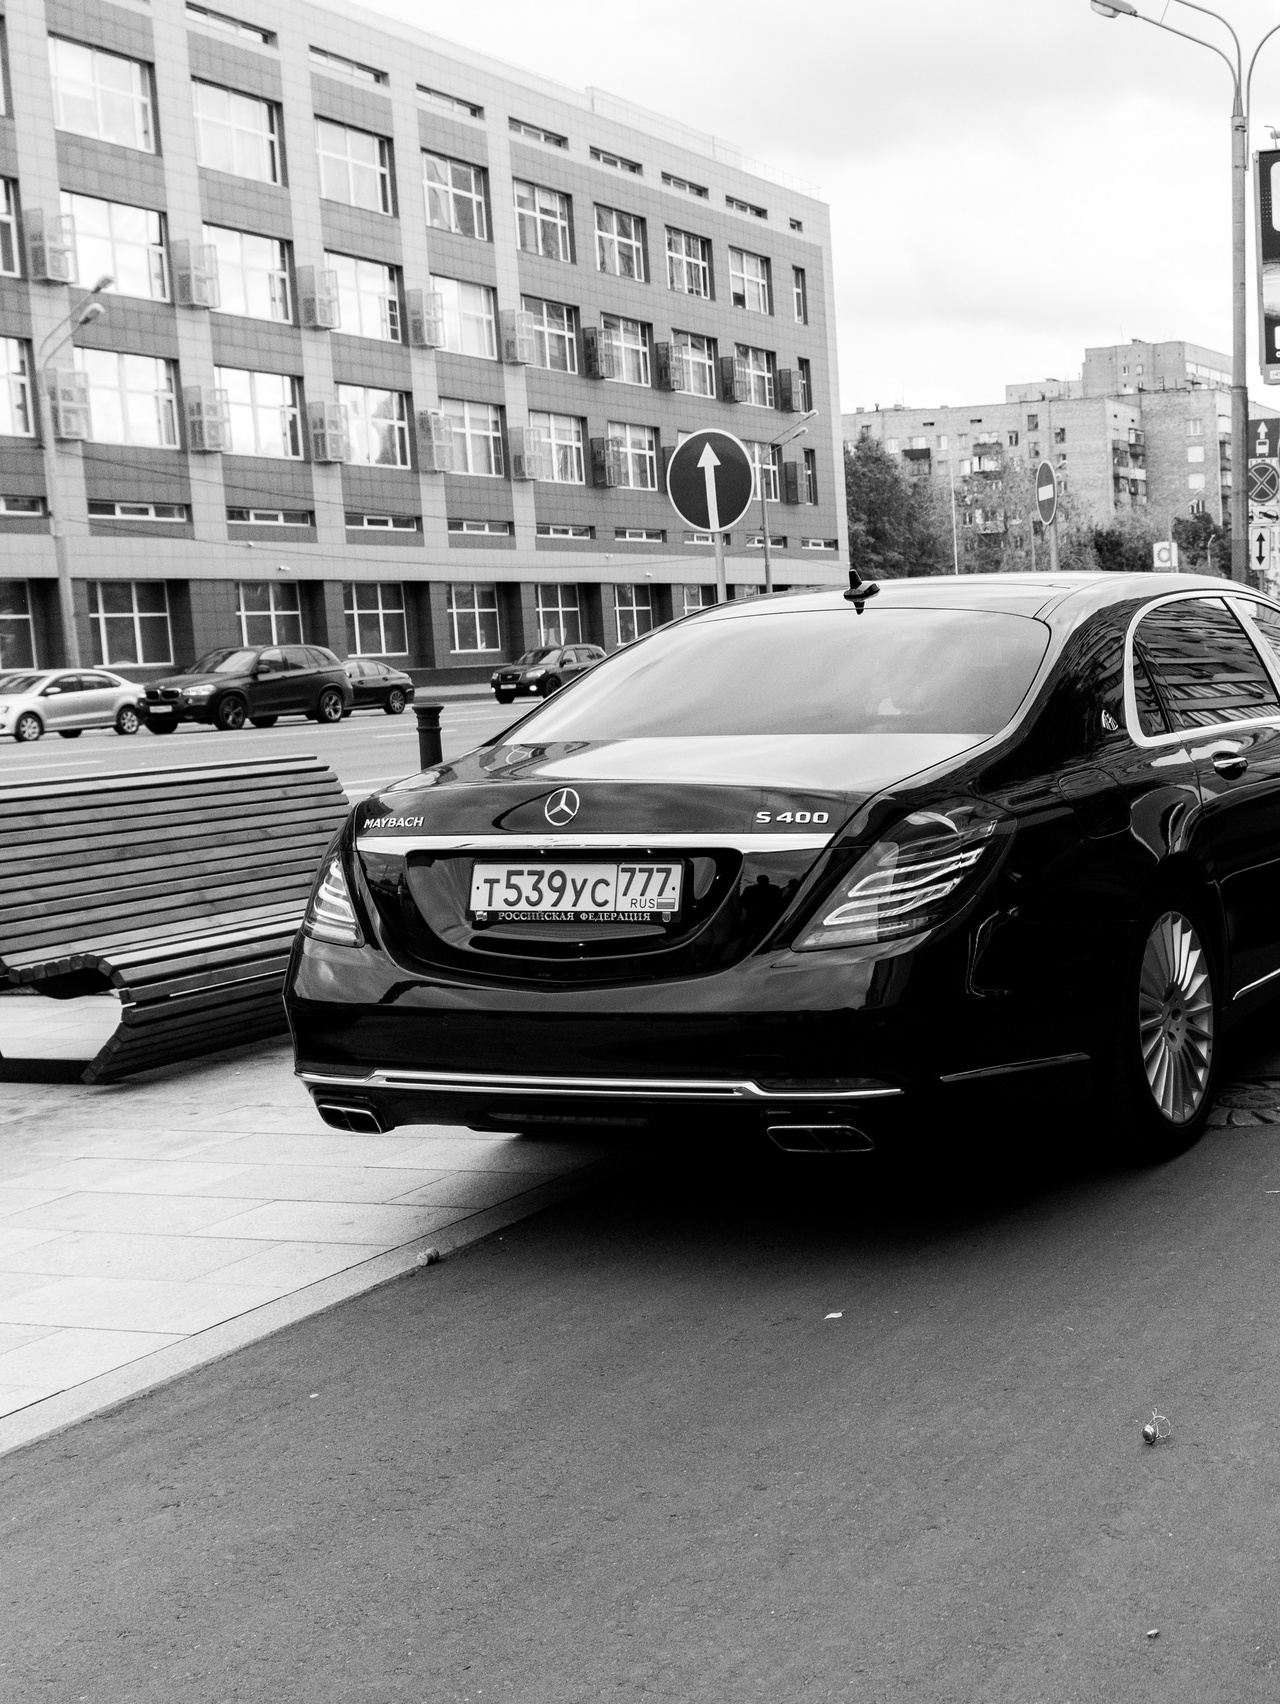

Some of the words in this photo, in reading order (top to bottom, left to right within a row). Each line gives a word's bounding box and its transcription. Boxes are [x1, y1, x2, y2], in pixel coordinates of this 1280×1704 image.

[363, 816, 425, 829] MAYBACH
[756, 811, 771, 824] S
[776, 811, 829, 824] 400
[620, 866, 673, 897] 777
[630, 898, 656, 909] RUS
[497, 911, 575, 922] РОССИЙСКАЯ
[579, 911, 652, 922] ФЕДЕРАЦИЯ
